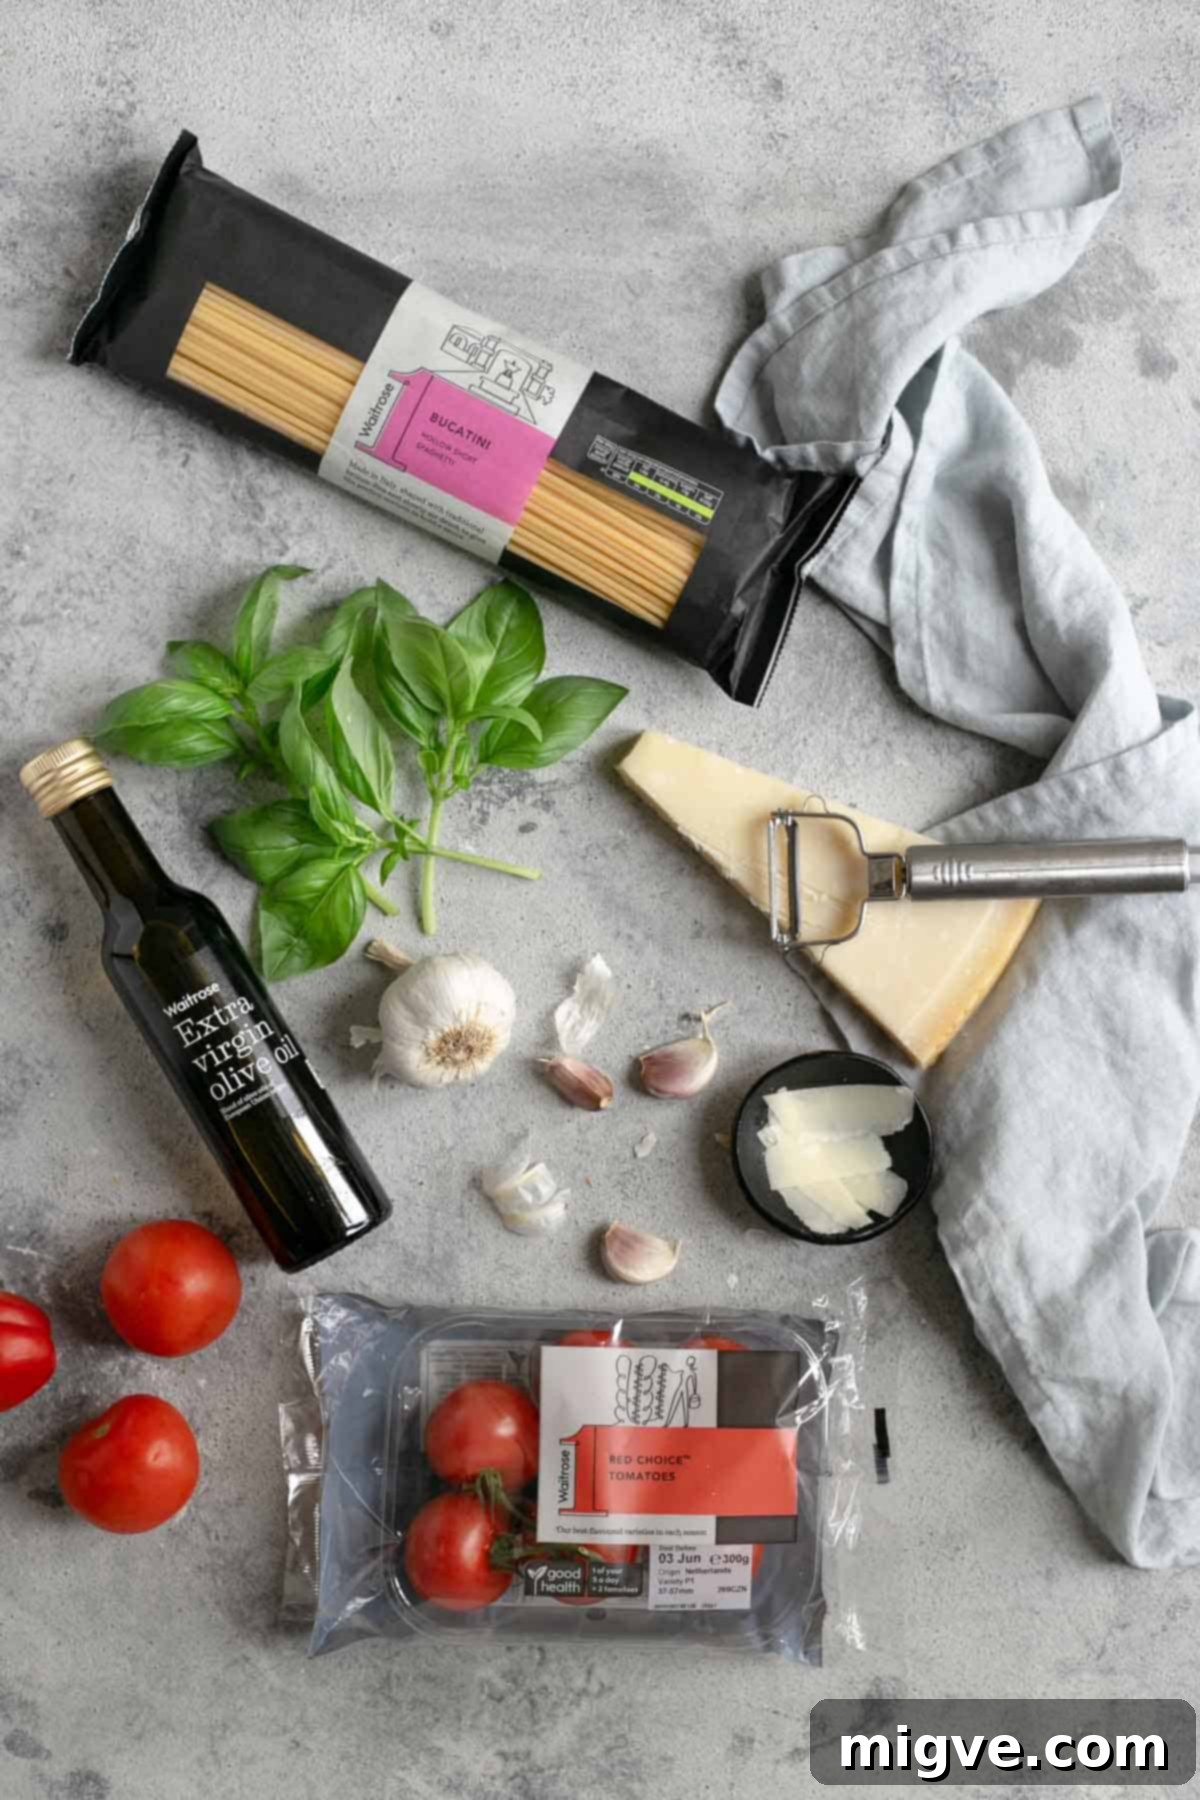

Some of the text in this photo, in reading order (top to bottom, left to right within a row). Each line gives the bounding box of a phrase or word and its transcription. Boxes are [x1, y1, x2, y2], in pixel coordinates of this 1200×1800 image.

[358, 383, 395, 437] Waitrose
[430, 412, 492, 449] BUCATINI
[347, 459, 370, 476] Made
[398, 485, 426, 506] shaped
[426, 500, 445, 514] with
[444, 508, 485, 535] traditional
[163, 983, 220, 1018] Waitrose
[173, 996, 254, 1048] Extra
[192, 1020, 274, 1073] virgin
[209, 1056, 272, 1101] olive
[274, 1034, 300, 1064] oil
[609, 1455, 632, 1465] RED
[558, 1449, 570, 1503] Waitrose
[609, 1471, 676, 1482] TOMATOES
[658, 1553, 674, 1564] 03
[677, 1553, 701, 1564] Jun
[547, 1567, 582, 1581] good
[606, 1568, 623, 1576] your
[658, 1569, 681, 1577] Origin
[541, 1580, 581, 1593] health
[605, 1575, 620, 1585] day
[658, 1578, 683, 1586] Variety
[604, 1585, 639, 1593] tomatoes
